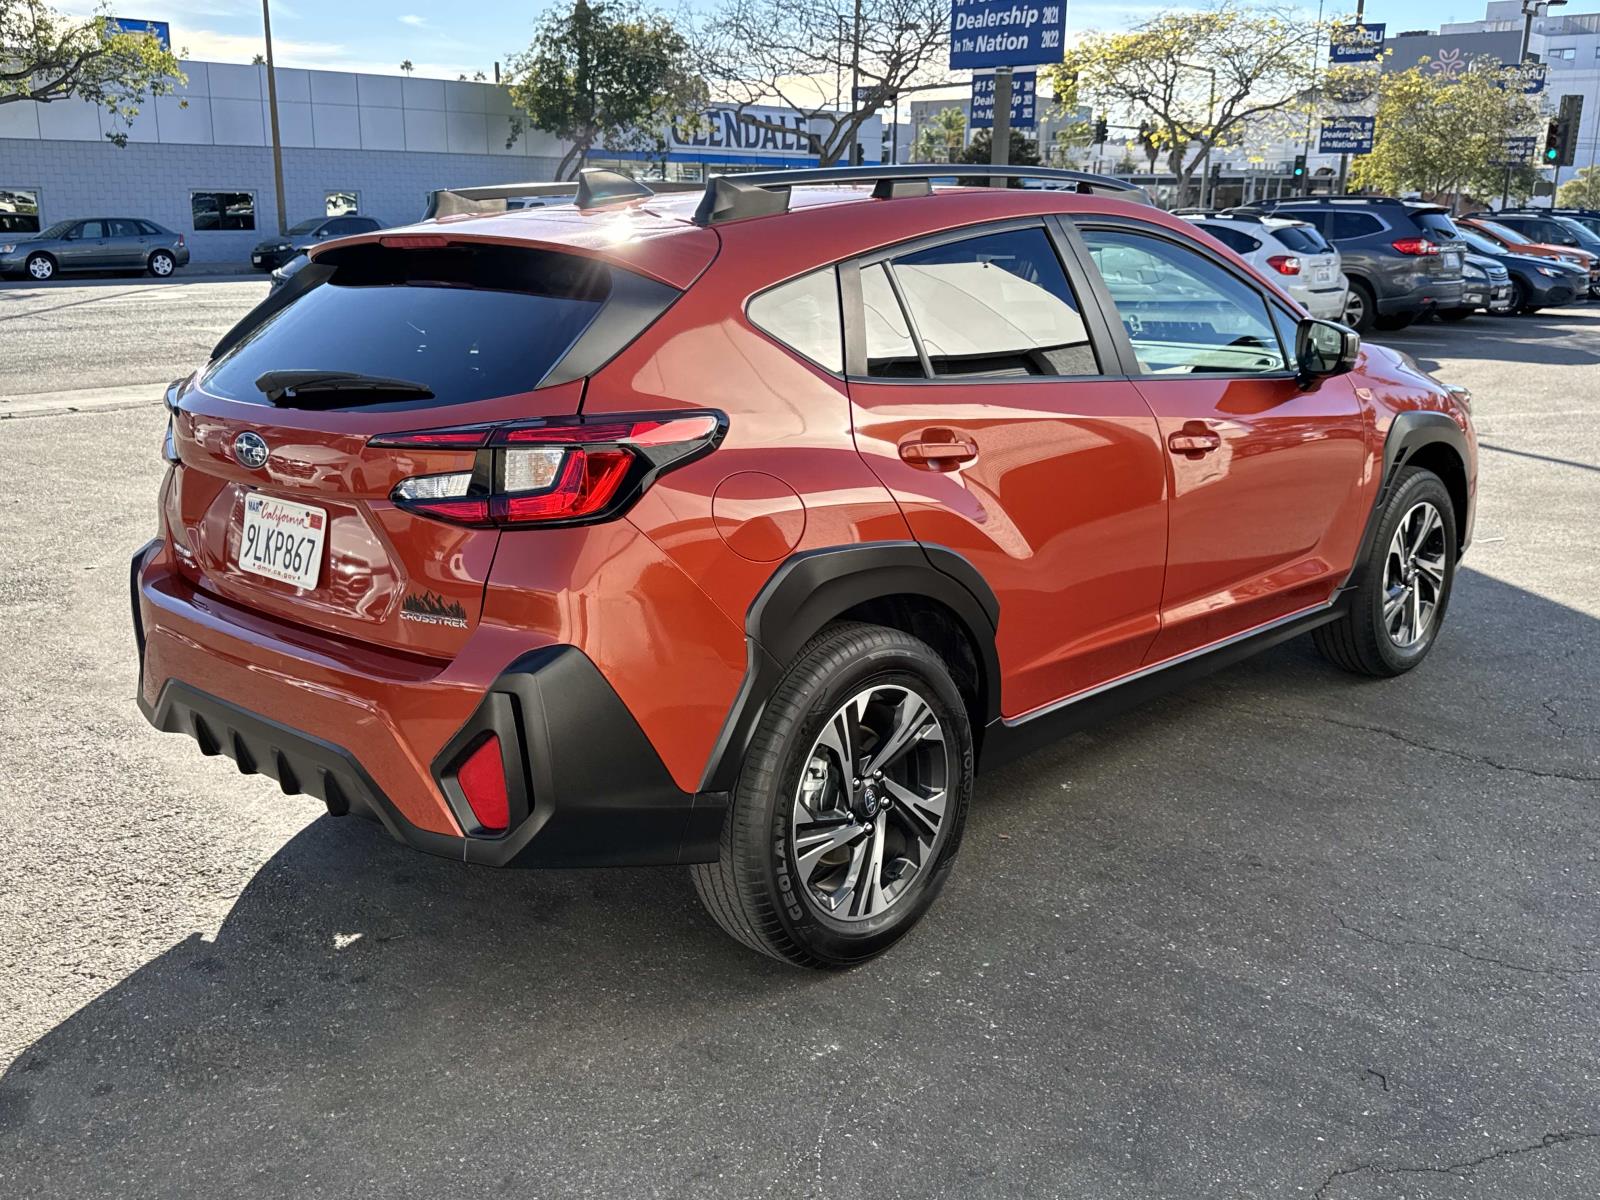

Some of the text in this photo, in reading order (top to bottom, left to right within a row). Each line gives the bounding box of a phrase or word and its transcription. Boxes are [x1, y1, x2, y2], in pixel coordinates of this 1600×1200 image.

[956, 5, 1039, 30] Dealership
[1042, 6, 1060, 25] 2021
[953, 32, 1029, 53] In The Nation
[1040, 29, 1060, 48] 2022
[974, 80, 987, 92] #1
[261, 502, 308, 529] California
[244, 523, 316, 576] 9LKP867
[400, 610, 468, 630] CROSSTREK
